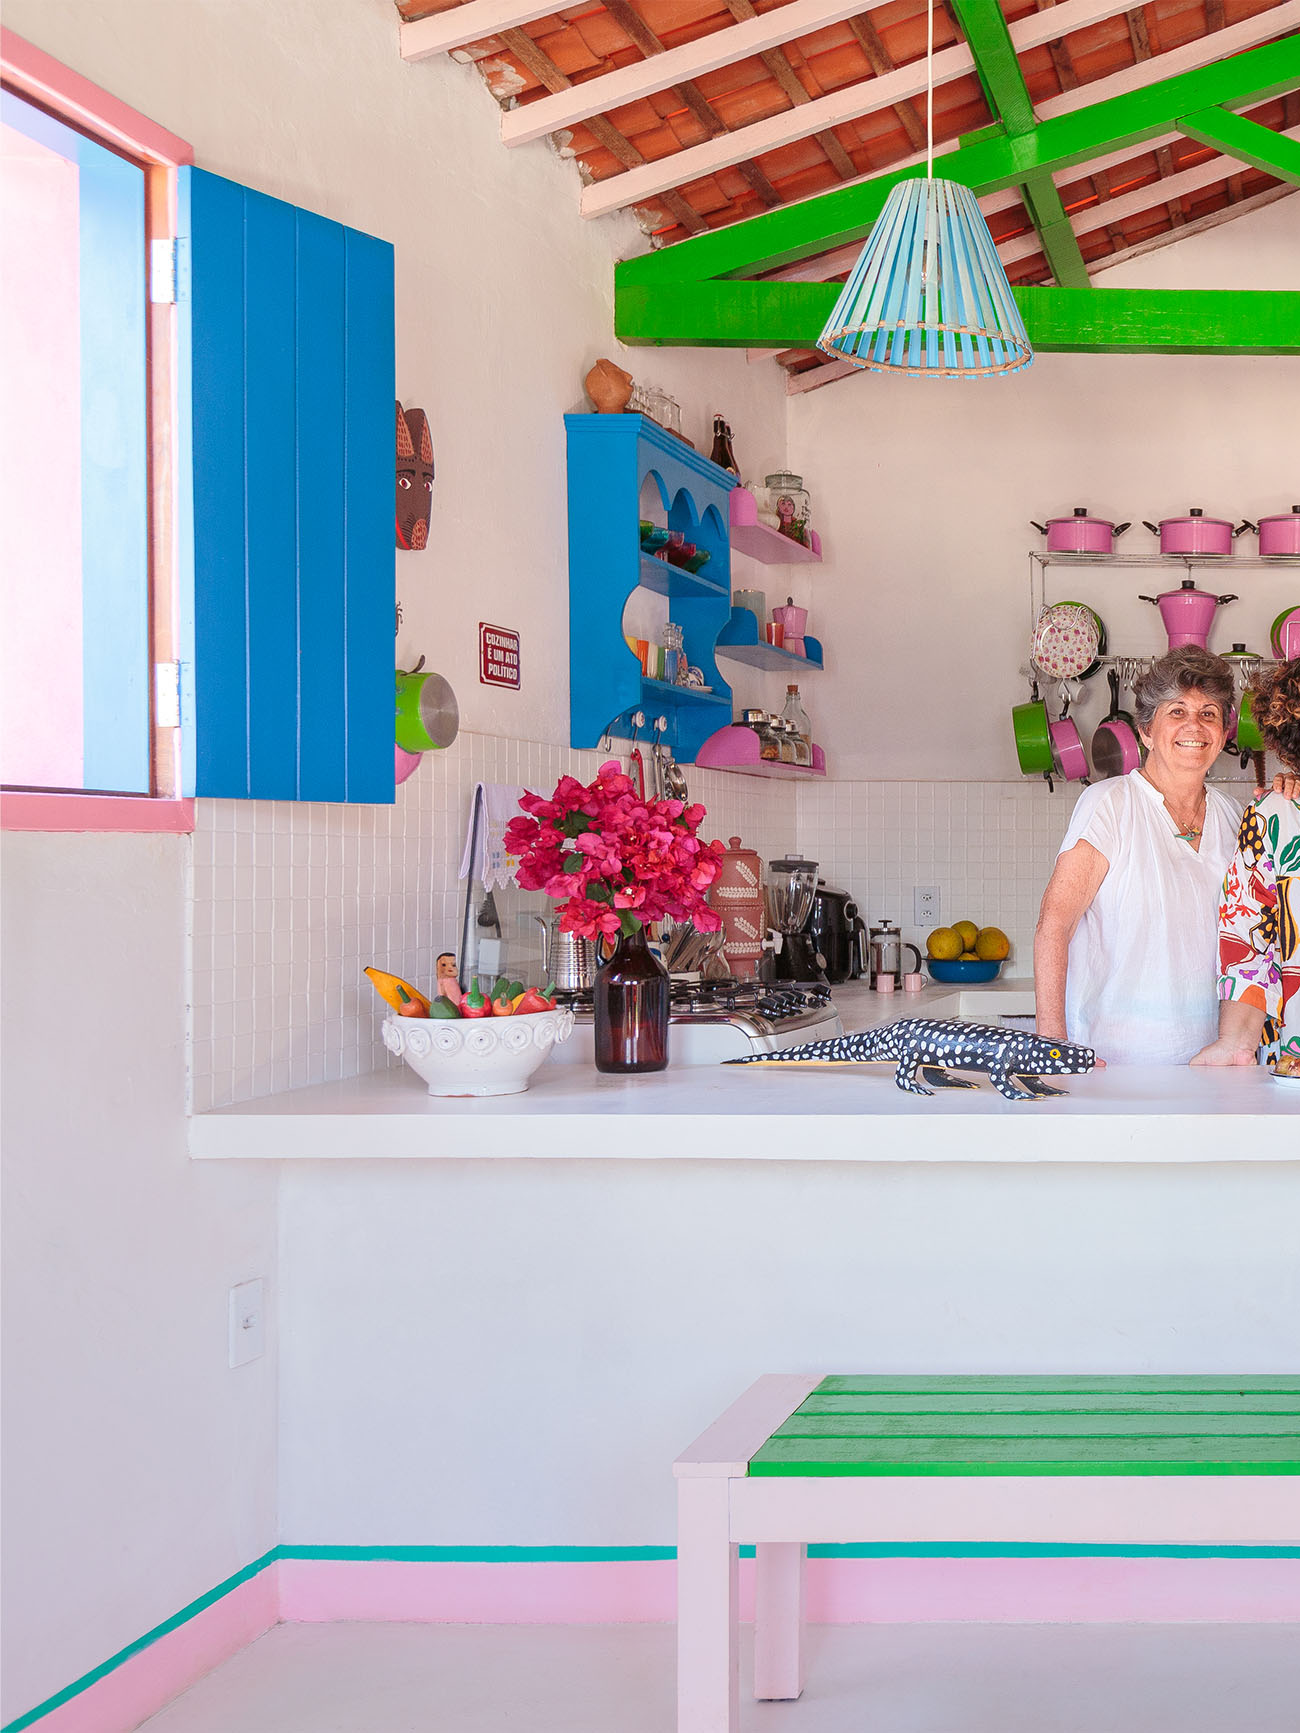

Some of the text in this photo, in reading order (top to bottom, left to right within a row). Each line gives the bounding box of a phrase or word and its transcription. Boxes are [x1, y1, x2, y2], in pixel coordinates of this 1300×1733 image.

[486, 632, 518, 650] COZINHAR
[488, 645, 518, 665] É UM ATO
[488, 663, 518, 680] POLÍTICO
